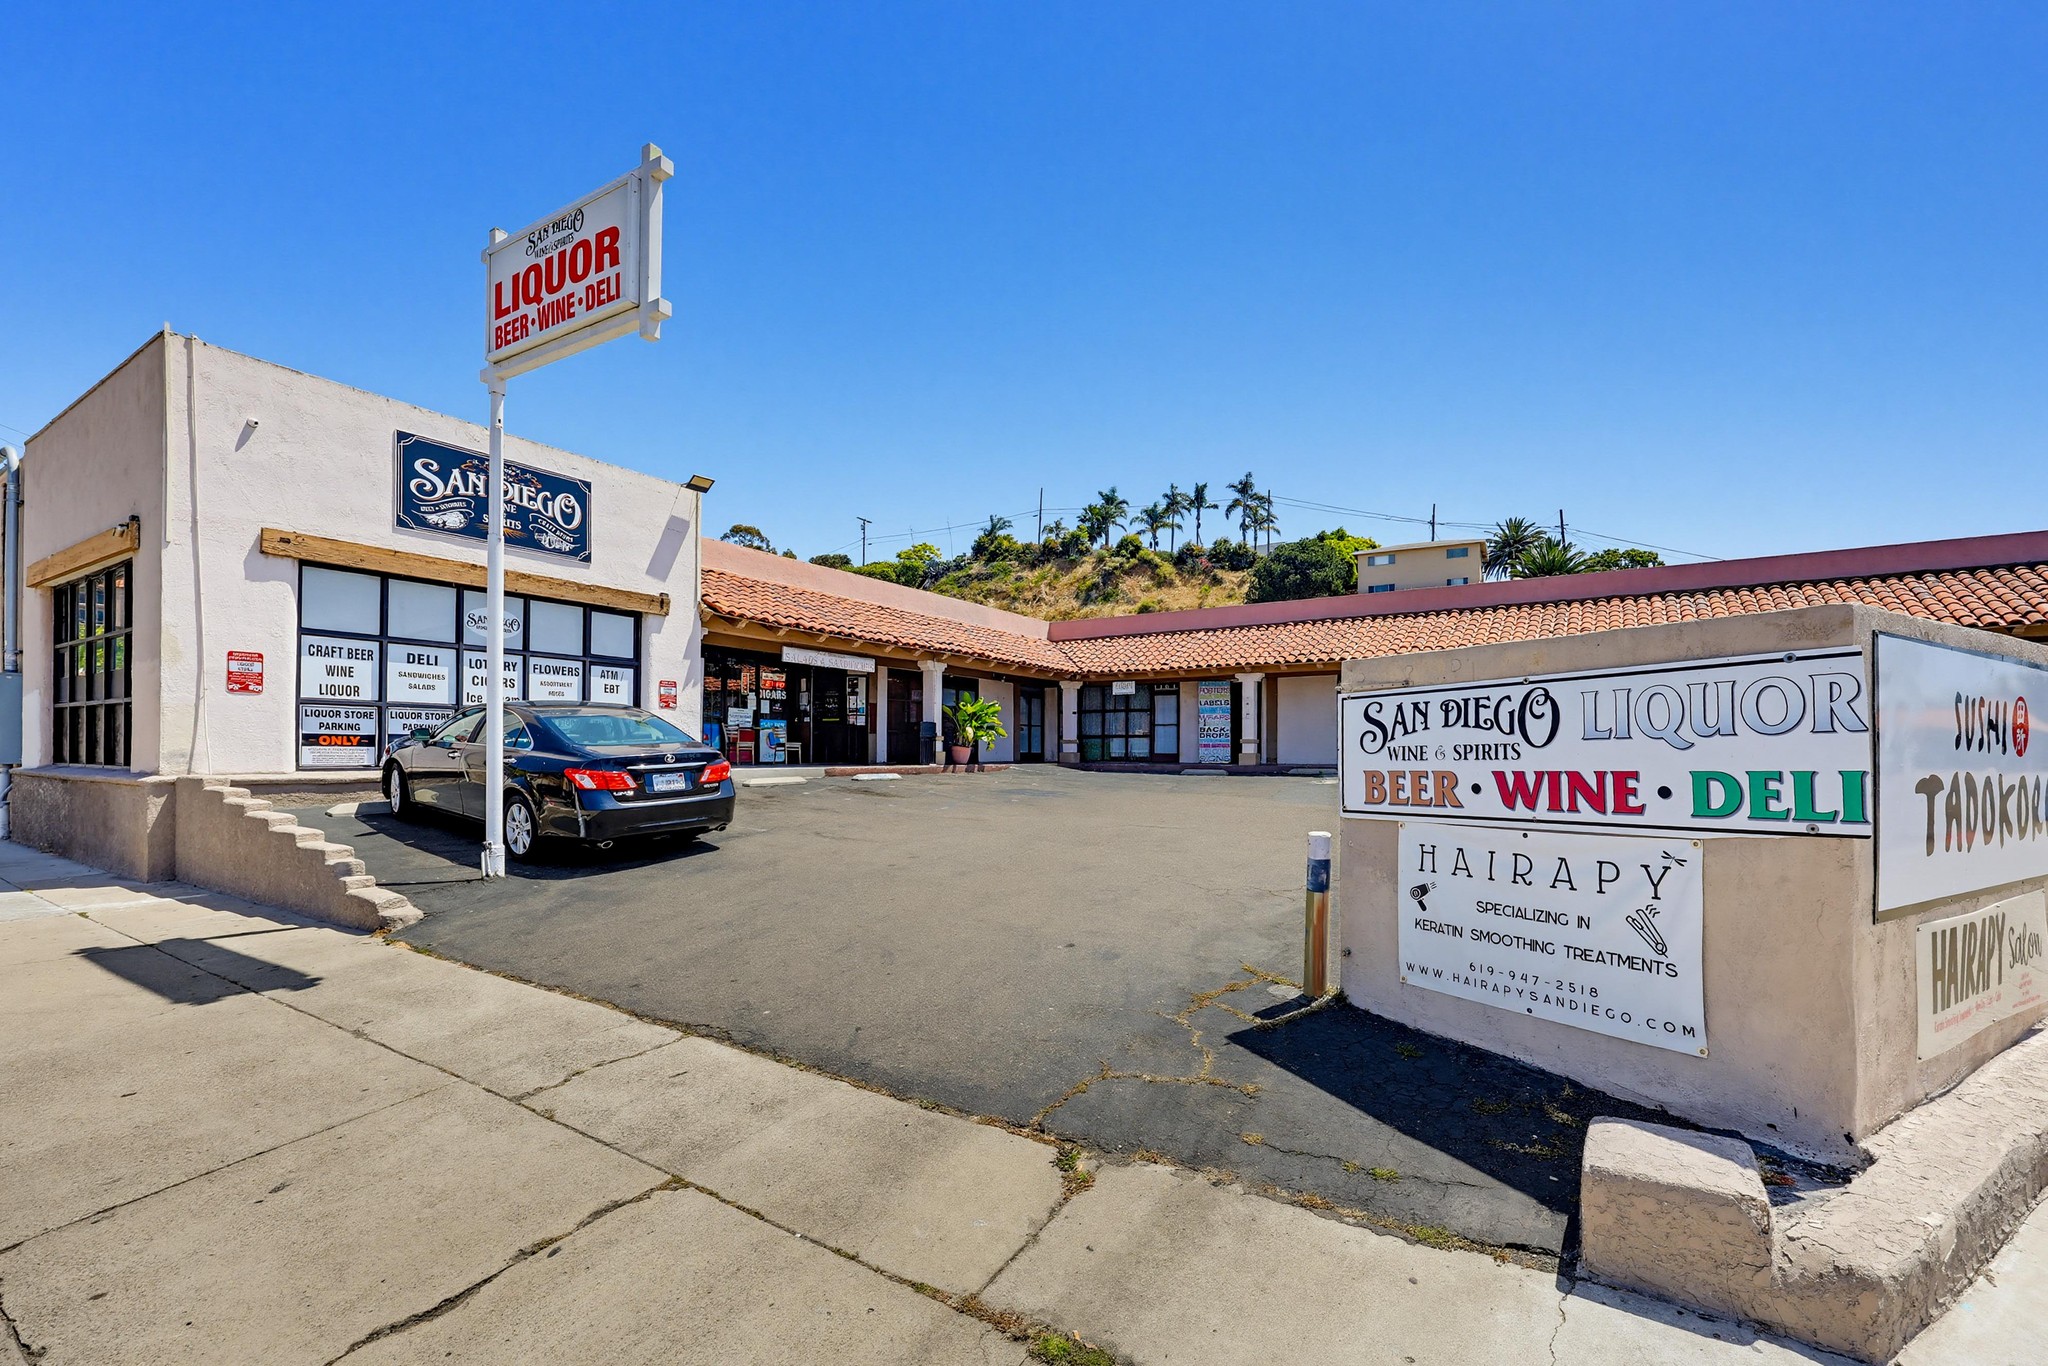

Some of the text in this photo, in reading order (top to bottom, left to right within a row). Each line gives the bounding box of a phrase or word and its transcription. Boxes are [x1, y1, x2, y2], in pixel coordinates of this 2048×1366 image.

[526, 208, 584, 256] SAN DIEGO
[495, 225, 620, 320] LIQUOR
[495, 272, 620, 350] BEER WINE DELI
[409, 458, 488, 500] SAN
[308, 644, 374, 661] CRAFT BEER
[406, 652, 438, 666] DELI
[785, 652, 817, 665] SALADS
[325, 665, 354, 678] WINE
[398, 671, 446, 681] SANDWICHES
[533, 664, 580, 677] FLOWERS
[600, 670, 618, 681] ATM
[319, 683, 360, 697] LIQUOR
[408, 683, 436, 691] SALADS
[604, 684, 620, 694] EBT
[466, 692, 483, 703] Ice
[304, 709, 374, 720] LIQUOR STORE
[390, 711, 422, 720] LIQUOR
[1360, 673, 1869, 754] SAN DIEGO LIQUOR
[319, 722, 360, 731] PARKING
[1955, 691, 2008, 755] SUSHI
[318, 736, 361, 746] ONLY
[1387, 743, 1521, 761] WINE & SPIRITS
[1363, 770, 1871, 824] BEER WINE DELI
[1418, 844, 1671, 900] HAIRAPY
[1476, 900, 1591, 930] SPECIALIZING IN
[1414, 918, 1678, 978] KERATIN SMOOTHING TREATMENTS
[1931, 912, 2006, 1015] HAIRAPY
[2008, 922, 2043, 969] Salon
[1469, 962, 1599, 998] 619-947-2518
[1406, 961, 1696, 1038] WWW.HAIRAPYSANDIEGO.COM
